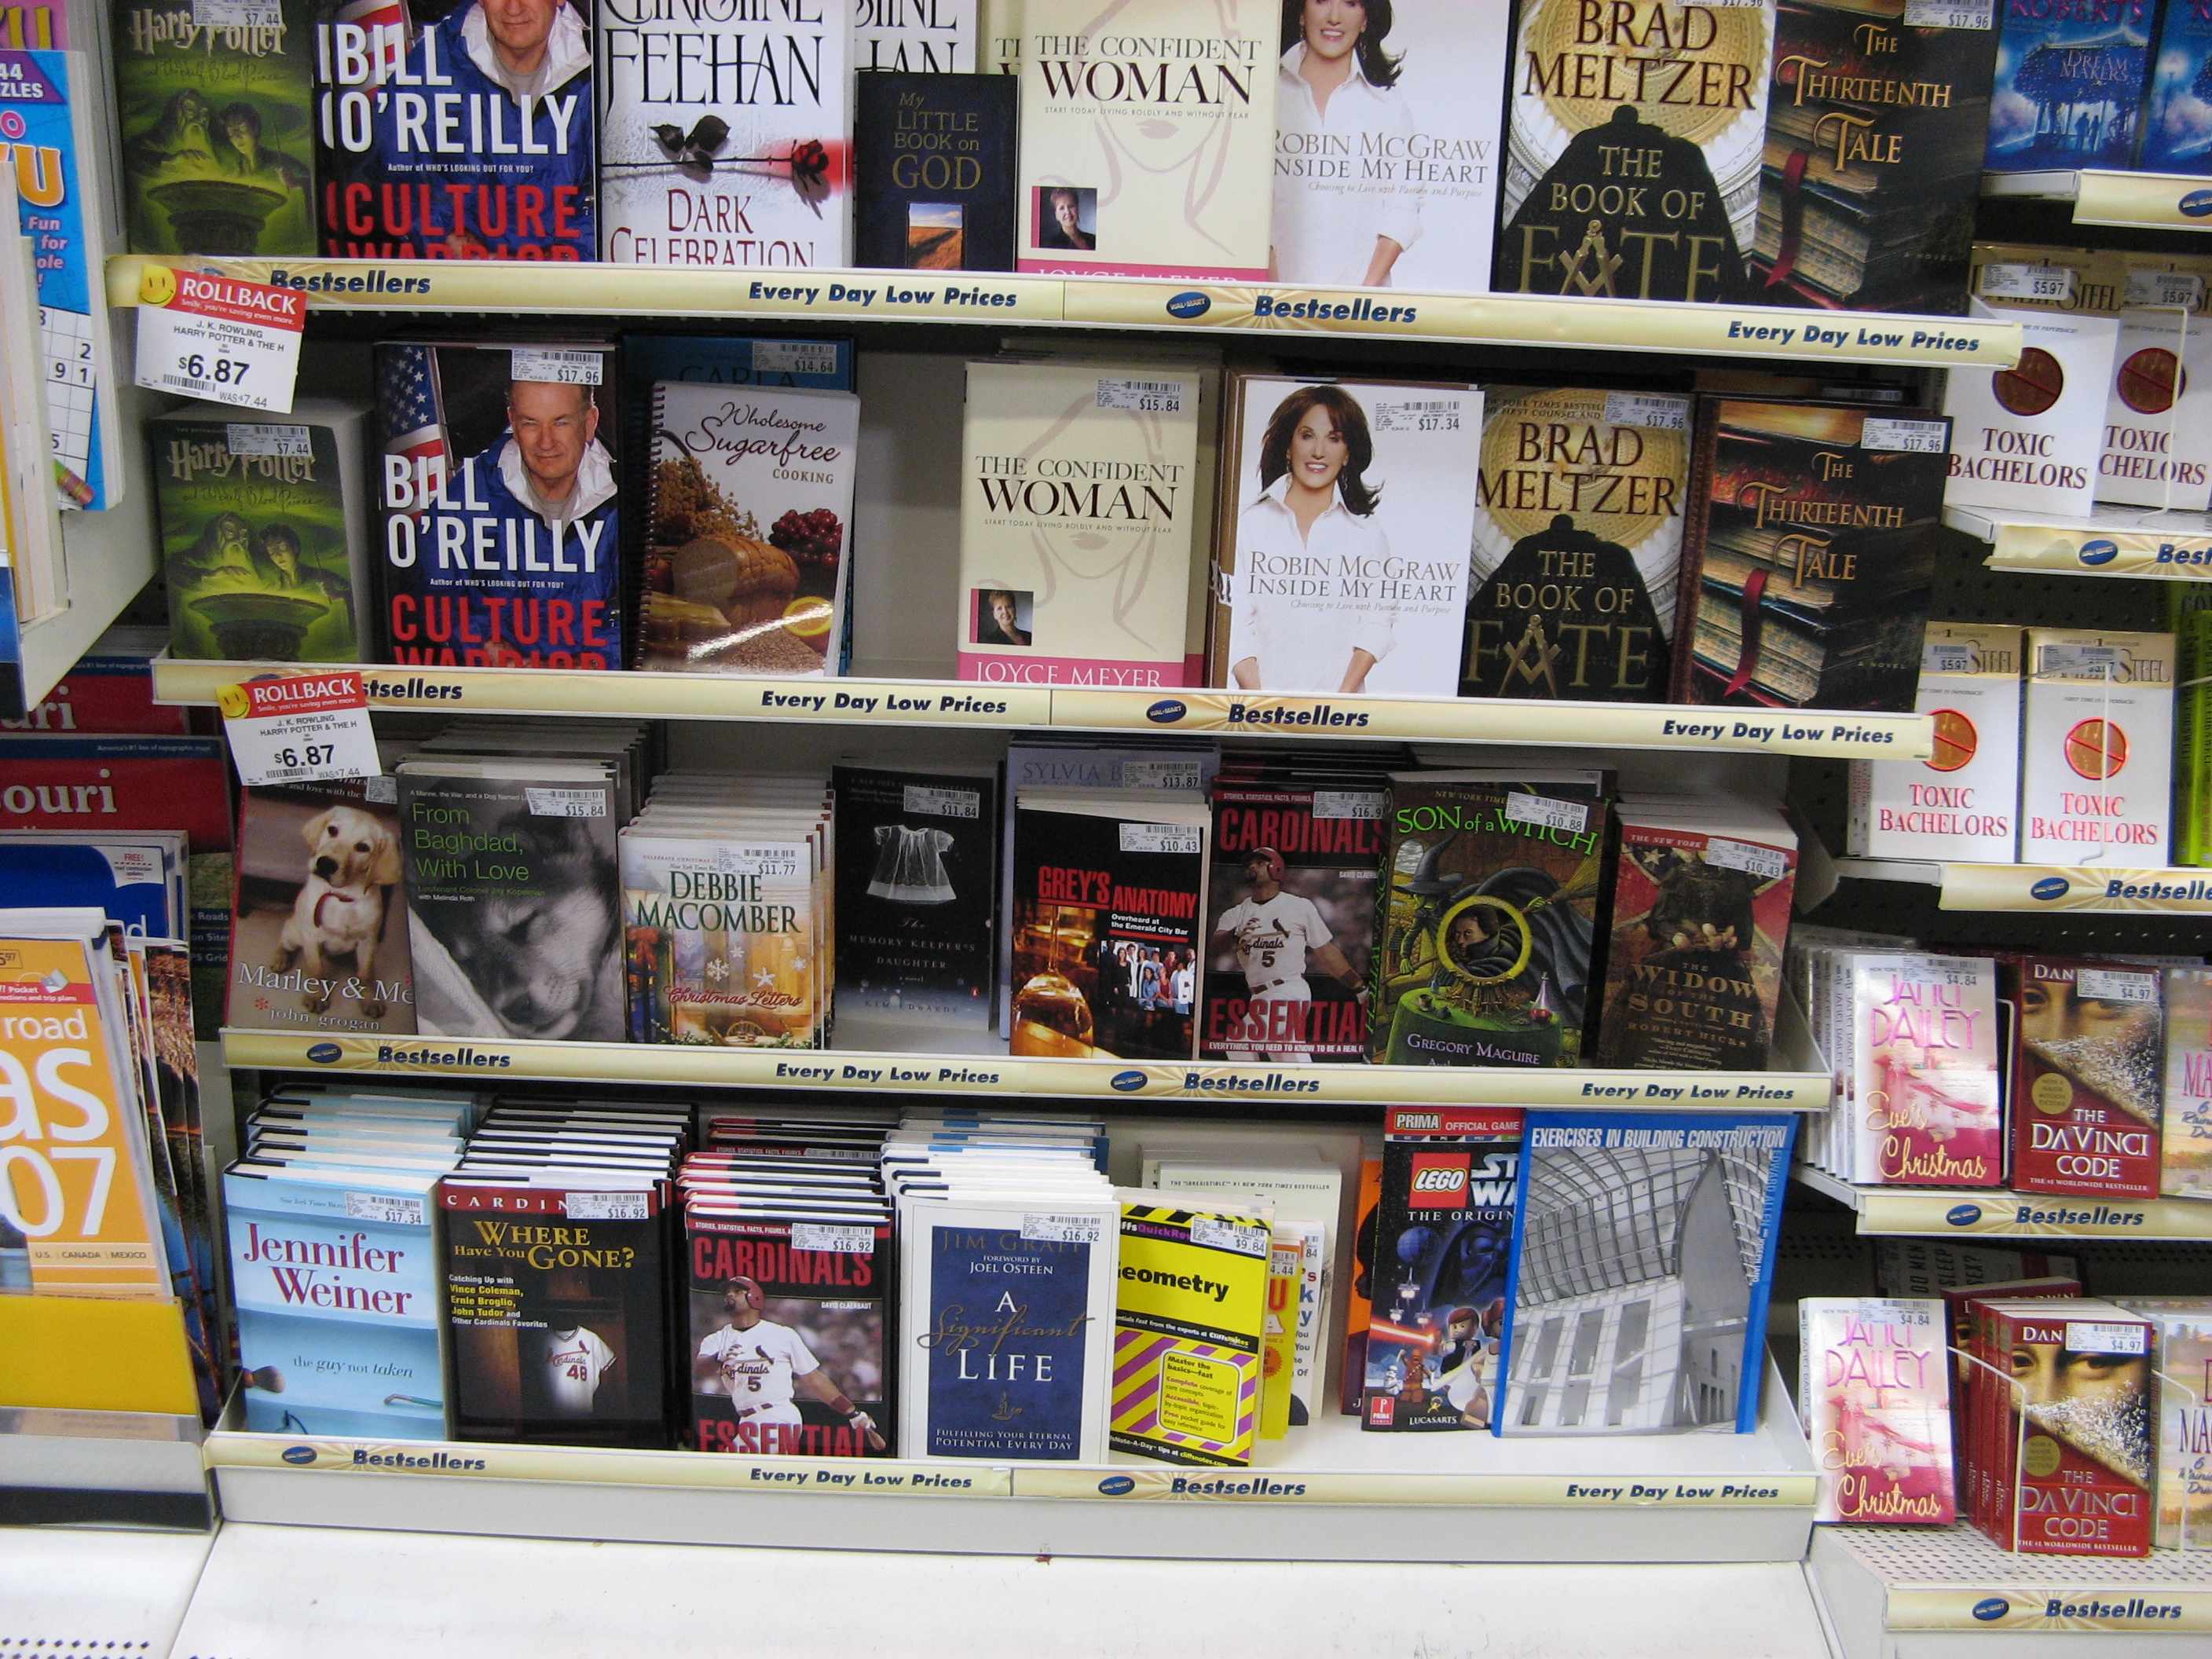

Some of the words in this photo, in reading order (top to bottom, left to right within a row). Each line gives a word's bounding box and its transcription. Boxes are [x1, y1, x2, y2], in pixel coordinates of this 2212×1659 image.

[245, 13, 279, 25] $7.44
[1035, 35, 1089, 57] THE
[1101, 36, 1262, 61] CONFIDENT
[1038, 61, 1256, 104] WOMAN
[1522, 52, 1756, 110] MELTZER
[1774, 55, 1951, 109] THIRTEENTH
[897, 112, 978, 132] LITTLE
[892, 155, 982, 191] GOD
[345, 181, 580, 238] CULTURE
[667, 189, 753, 233] DARK
[27, 216, 60, 232] Fun
[182, 278, 297, 315] ROLLBACK
[749, 282, 819, 305] Every
[829, 284, 877, 306] Day
[886, 286, 936, 305] Low
[944, 287, 1017, 308] Prices
[174, 325, 207, 339] HARRY
[208, 331, 245, 346] POTTER
[258, 340, 275, 350] THE
[207, 321, 216, 330] K.
[219, 324, 263, 339] ROWLING
[1728, 321, 1796, 346] Every
[1803, 324, 1848, 348] Day
[1858, 326, 1903, 347] Low
[1910, 330, 1979, 353] Prices
[178, 354, 250, 386] $6.87
[557, 368, 600, 385] $17.96
[794, 359, 836, 373] $14.64
[1139, 398, 1181, 412] $15.84
[720, 401, 827, 433] Wholesome
[1645, 415, 1685, 429] $17.96
[276, 443, 309, 455] $7.44
[1515, 422, 1645, 468] BRAD
[1982, 427, 2055, 458] TOXIC
[383, 453, 490, 513] BILL
[772, 468, 835, 485] COOKING
[977, 477, 1179, 522] WOMAN
[387, 515, 606, 574] O'REILLY
[1249, 550, 1331, 577] ROBIN
[1538, 551, 1597, 578] THE
[1248, 576, 1331, 597] INSIDE
[1339, 578, 1375, 599] MY
[1381, 580, 1457, 602] HEART
[1496, 583, 1586, 611] BOOK
[1594, 587, 1635, 613] OF
[254, 679, 356, 704] ROLLBACK
[760, 690, 826, 712] Every
[834, 693, 879, 715] Day
[887, 694, 932, 712] Low
[939, 697, 1007, 714] Prices
[296, 715, 335, 725] ROWLING
[1228, 703, 1369, 728] Bestsellers
[1910, 785, 1975, 808] TOXIC
[412, 803, 470, 824] From
[565, 804, 604, 816] $15.84
[1545, 814, 1582, 830] $10.88
[1879, 808, 2009, 837] BACHELORS
[415, 829, 524, 855] Baghdad,
[1159, 840, 1198, 852] $10.43
[1632, 834, 1650, 843] THE
[1653, 836, 1675, 845] NEW
[1677, 838, 1702, 848] YORK
[416, 858, 467, 880] With
[475, 860, 529, 881] Love
[758, 864, 796, 875] $11.77
[669, 870, 762, 902] DEBBIE
[1038, 865, 1111, 902] GREY'S
[1112, 884, 1198, 920] ANATOMY
[637, 899, 802, 933] MACOMBER
[1111, 913, 1150, 925] Overheard
[1152, 916, 1159, 925] at
[1262, 952, 1276, 969] 5
[1946, 974, 1977, 985] $4.84
[2122, 987, 2151, 1000] $4.97
[269, 1007, 309, 1026] john
[319, 1013, 382, 1031] grogan
[1628, 993, 1753, 1030] SOUTH
[377, 1045, 511, 1068] Bestsellers
[1407, 1032, 1473, 1056] GREGORY
[1476, 1041, 1540, 1065] MAGUIRE
[776, 1062, 836, 1082] Every
[841, 1065, 883, 1082] Day
[889, 1066, 932, 1082] Low
[938, 1068, 999, 1085] Prices
[1184, 1072, 1320, 1093] Bestsellers
[1394, 1113, 1441, 1130] PRIMA
[1445, 1122, 1488, 1132] OFFICIAL
[1491, 1120, 1520, 1130] GAME
[2073, 1108, 2106, 1123] THE
[1531, 1128, 1603, 1148] EXERCISES
[1606, 1129, 1622, 1148] IN
[1624, 1129, 1685, 1148] BUILDING
[1686, 1128, 1786, 1148] CONSTRUCTION
[1878, 1137, 1987, 1180] Christmas
[2056, 1155, 2121, 1178] CODE
[1413, 1168, 1467, 1192] LEGO
[384, 1211, 423, 1225] $17.34
[607, 1207, 646, 1220] $16.92
[474, 1221, 591, 1246] WHERE
[1063, 1230, 1100, 1242] $16.92
[61, 1251, 101, 1259] CANADA
[111, 1251, 147, 1259] MEXICO
[243, 1221, 405, 1274] Jennifer
[455, 1246, 491, 1257] Have
[497, 1247, 525, 1258] You
[528, 1245, 635, 1270] GONE?
[833, 1241, 871, 1251] $16.92
[694, 1236, 873, 1287] CARDINALS
[969, 1262, 999, 1274] JOEL
[1003, 1263, 1053, 1275] OSTEEN
[270, 1265, 413, 1315] Weiner
[450, 1284, 475, 1295] Vince
[478, 1286, 523, 1297] Coleman,
[994, 1290, 1019, 1313] A
[452, 1307, 474, 1317] John
[478, 1308, 504, 1317] Tudor
[1900, 1314, 1931, 1325] $4.84
[2111, 1339, 2142, 1353] $4.97
[293, 1356, 315, 1368] the
[316, 1358, 346, 1375] guy
[348, 1362, 369, 1374] not
[372, 1363, 414, 1379] taken
[566, 1365, 588, 1382] 48
[957, 1348, 1055, 1382] LIFE
[748, 1376, 762, 1393] 5
[1409, 1415, 1457, 1426] LUCASARTS
[936, 1428, 995, 1440] FULFILLING
[998, 1431, 1027, 1440] YOUR
[1029, 1432, 1072, 1441] ETERNAL
[936, 1437, 1005, 1449] POTENTIAL
[1007, 1440, 1046, 1451] EVERY
[1048, 1441, 1074, 1452] DAY
[352, 1449, 486, 1470] Bestsellers
[1171, 1478, 1306, 1497] Bestsellers
[2062, 1470, 2093, 1485] THE
[1566, 1484, 1624, 1499] Every
[1630, 1484, 1669, 1500] Day
[1675, 1485, 1714, 1498] Low
[1720, 1485, 1778, 1499] Prices
[2044, 1517, 2109, 1540] CODE
[2044, 1540, 2092, 1550] WORLDWIDE
[2093, 1543, 2137, 1552] BESTSELLER
[2045, 1598, 2182, 1620] Bestsellers
